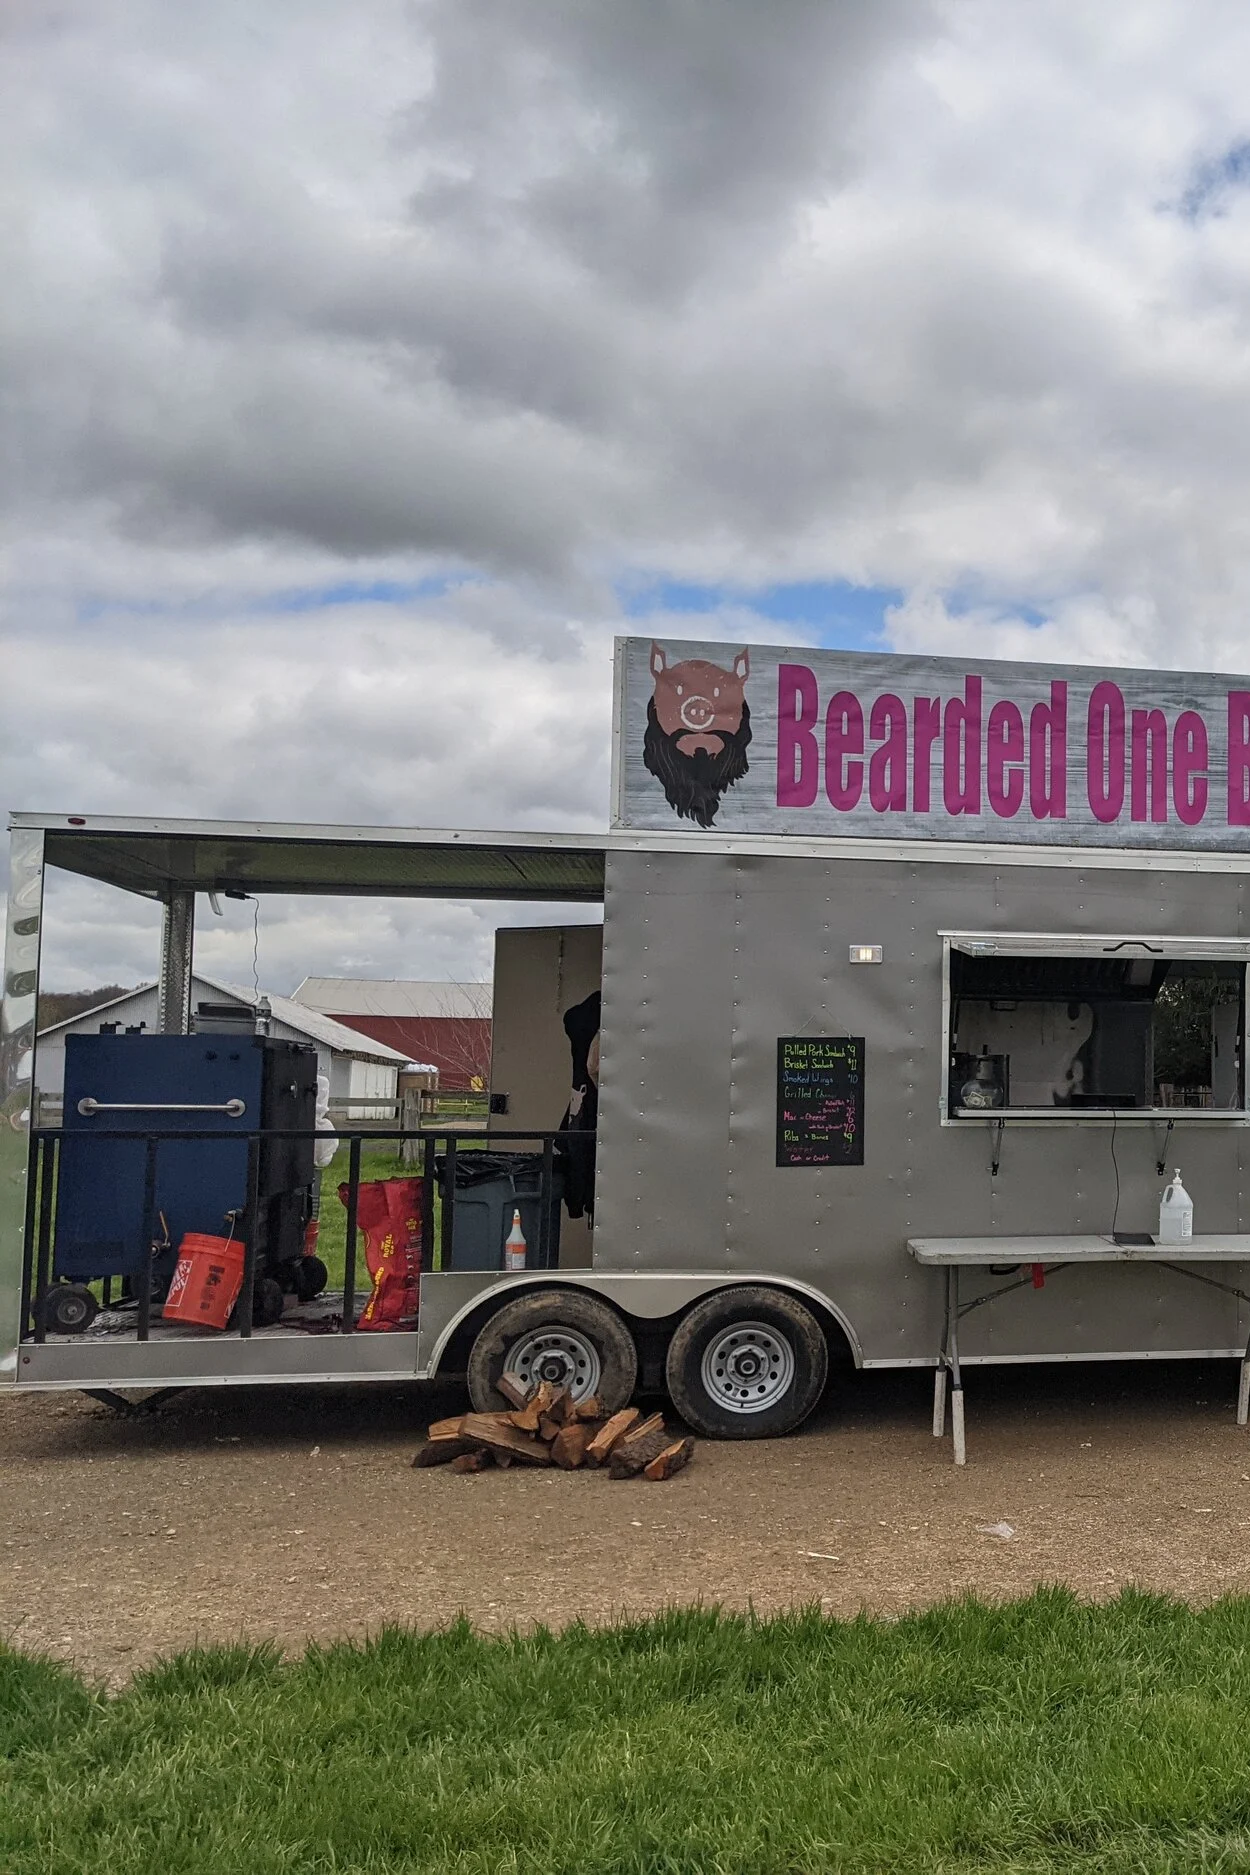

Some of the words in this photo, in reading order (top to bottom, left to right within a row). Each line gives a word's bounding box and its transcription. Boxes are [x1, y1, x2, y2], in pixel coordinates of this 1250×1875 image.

[776, 664, 1068, 819] Bearded
[1087, 680, 1208, 824] One
[784, 1044, 807, 1056] Pulled
[808, 1043, 824, 1056] Pork
[784, 1057, 808, 1069] Brisket
[783, 1070, 810, 1083] Smoked
[811, 1072, 834, 1086] Wings
[784, 1085, 812, 1098] Grilled
[783, 1110, 798, 1121] Mac
[805, 1112, 828, 1121] Cheese
[784, 1129, 800, 1142] Ribs
[811, 1133, 829, 1141] Bones
[790, 1154, 802, 1162] Cash
[813, 1153, 830, 1162] Credit
[383, 1234, 392, 1257] ROYAL
